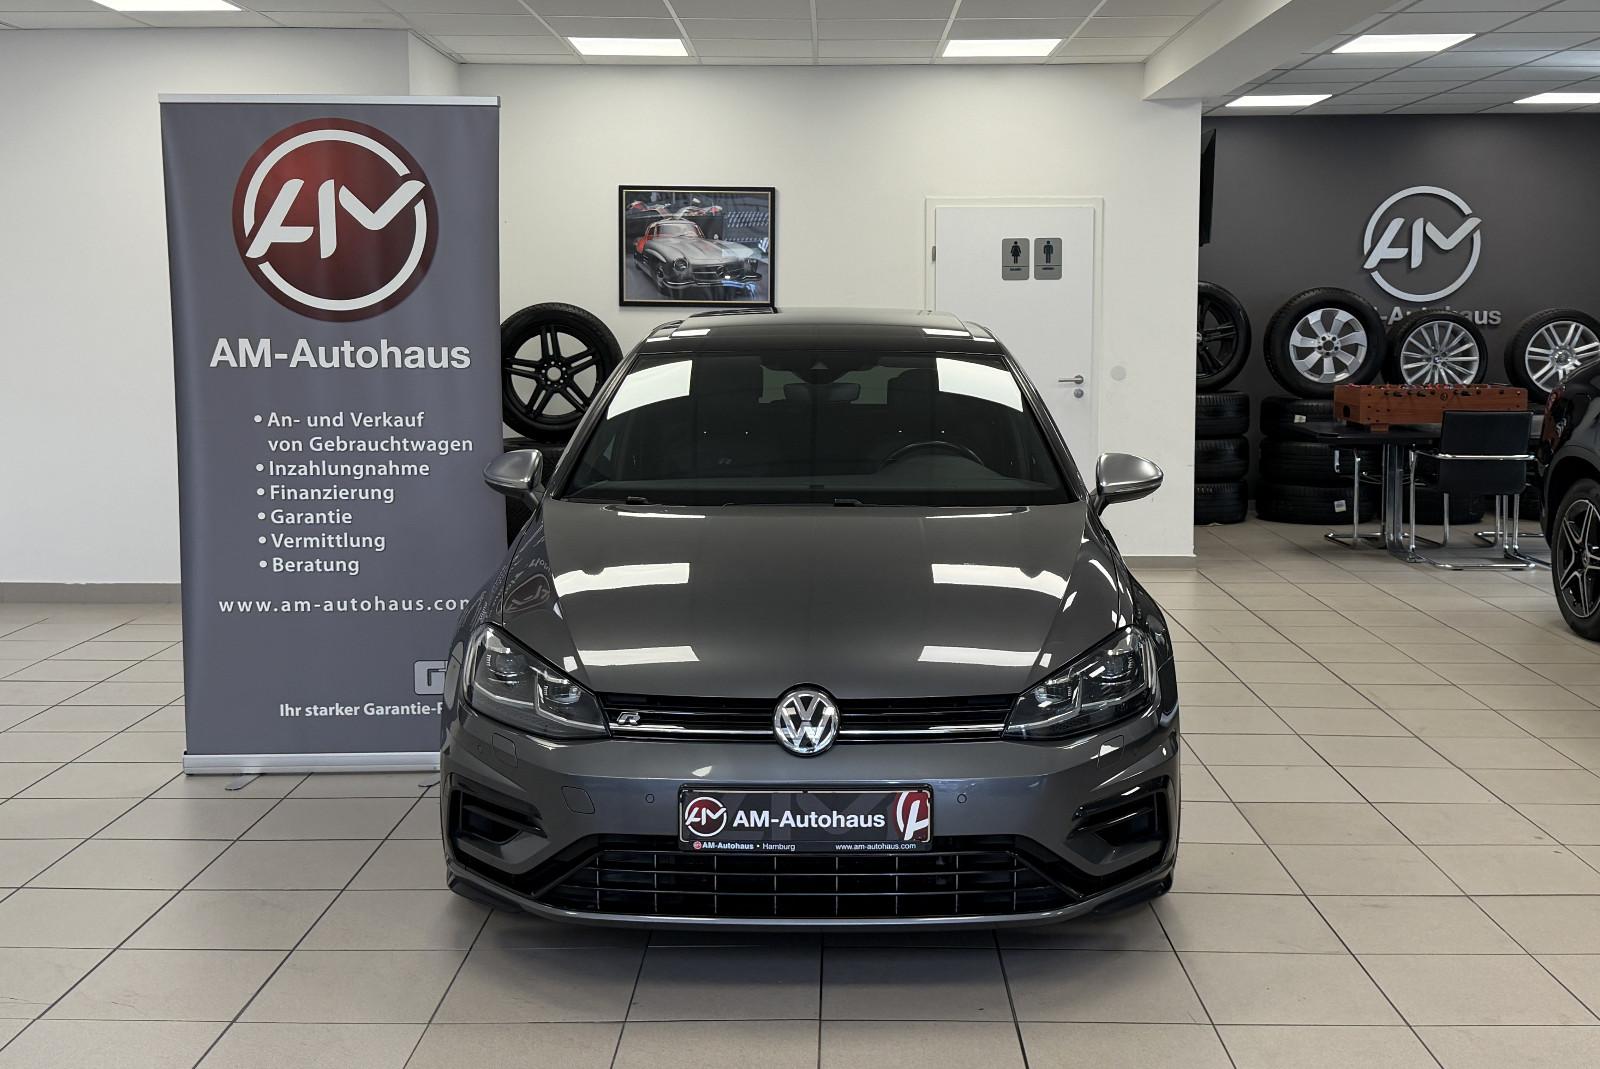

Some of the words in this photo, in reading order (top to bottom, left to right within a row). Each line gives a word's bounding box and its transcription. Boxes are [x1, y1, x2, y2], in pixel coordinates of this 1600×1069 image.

[209, 337, 471, 369] AM-Autohaus
[267, 411, 301, 428] An-
[307, 411, 344, 428] und
[350, 411, 425, 428] Verkauf
[268, 439, 303, 452] von
[309, 436, 473, 455] Gebrauchtwagen
[269, 460, 430, 480] Inzahlungnahme
[269, 484, 395, 504] Finanzierung
[270, 508, 353, 524] Garantie
[271, 533, 387, 552] Vermittlung
[272, 557, 360, 576] Beratung
[279, 703, 302, 717] Ihr
[305, 703, 361, 717] starker
[776, 690, 837, 753] VW
[732, 810, 886, 828] AM-Autohaus
[702, 841, 754, 850] AM-Autohaus
[762, 842, 796, 852] Hamburg
[835, 842, 917, 851] www.am-autohaus.com
